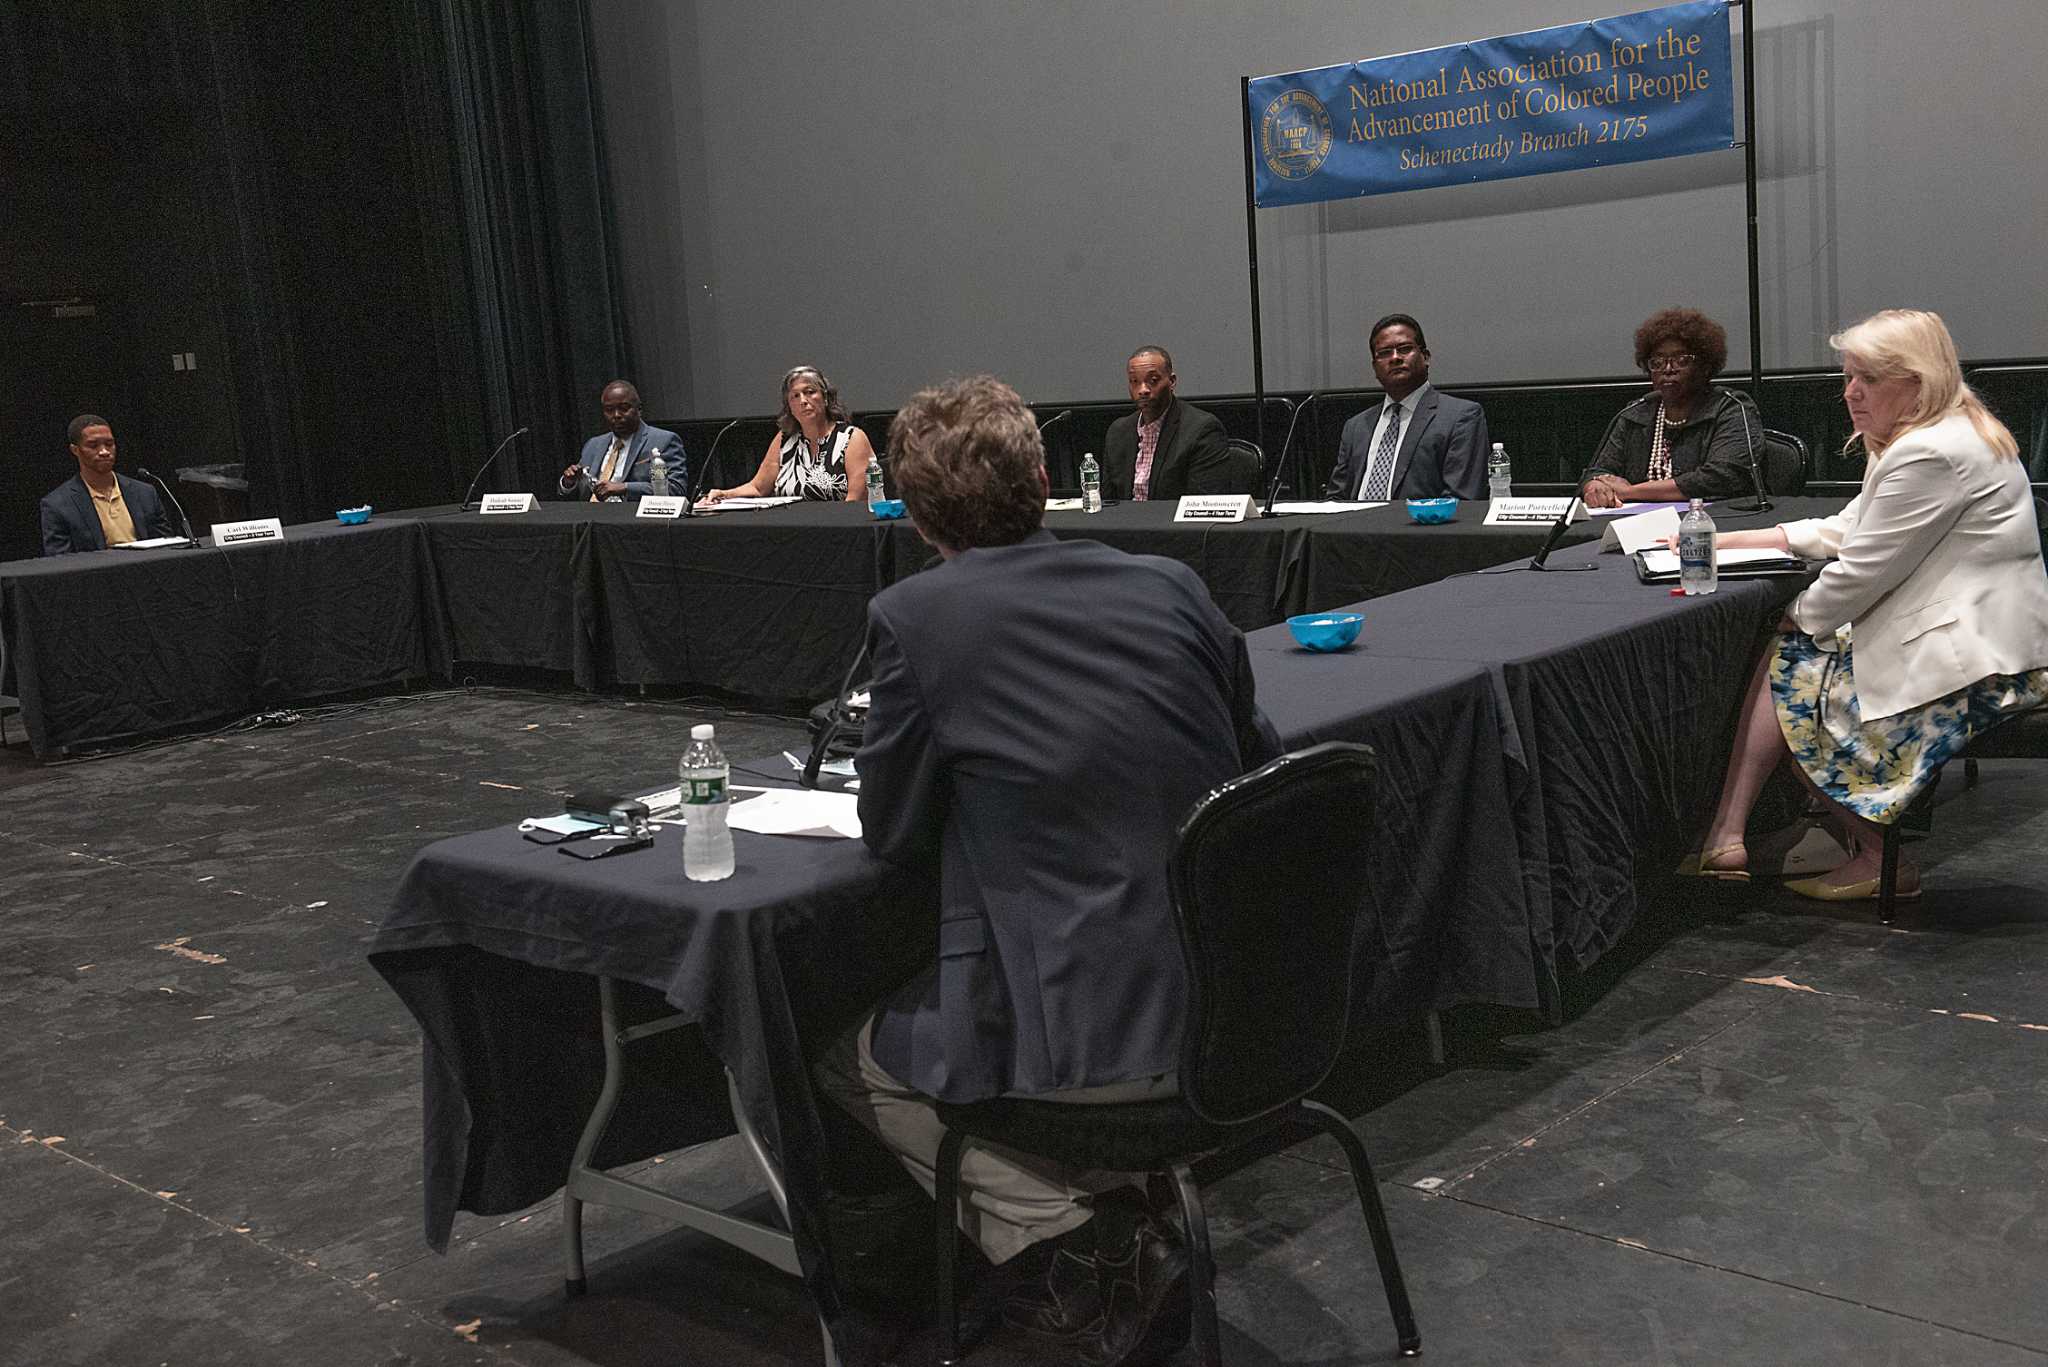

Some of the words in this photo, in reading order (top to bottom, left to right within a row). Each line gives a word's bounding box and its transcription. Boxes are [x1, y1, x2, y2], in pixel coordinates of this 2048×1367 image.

[1348, 97, 1493, 143] Advancement
[1497, 89, 1521, 120] of
[1525, 75, 1619, 116] Colored
[1628, 62, 1710, 103] People
[1349, 68, 1447, 110] National
[1455, 50, 1603, 95] Association
[1611, 38, 1648, 69] for
[1656, 28, 1701, 60] the
[1399, 134, 1514, 169] Schenectady
[1519, 123, 1590, 154] Branch
[1596, 115, 1649, 144] 2175
[1499, 503, 1526, 511] Marion
